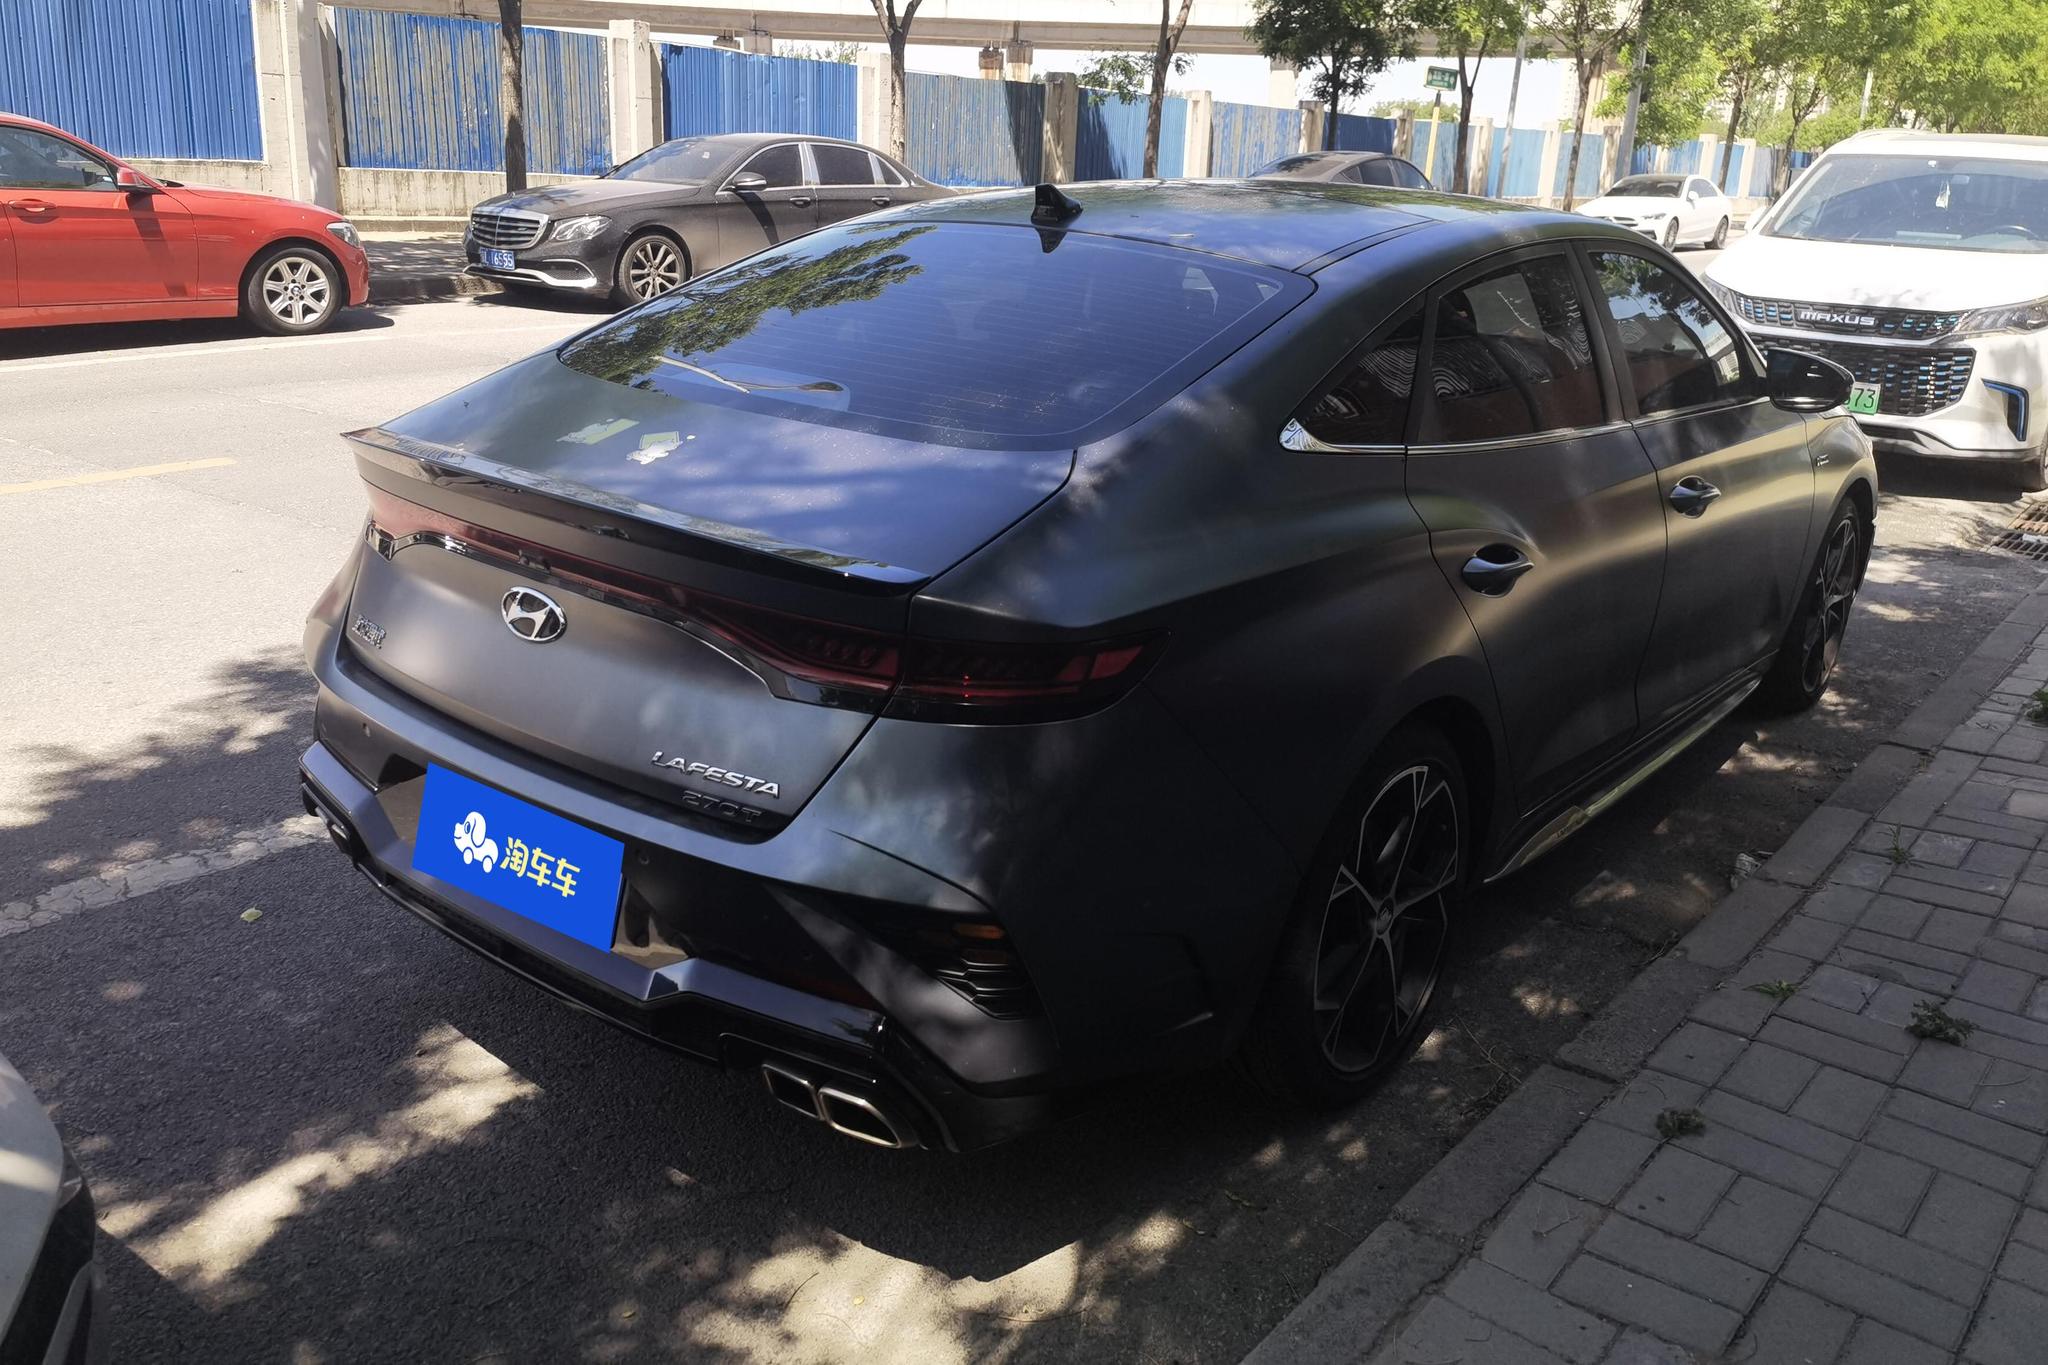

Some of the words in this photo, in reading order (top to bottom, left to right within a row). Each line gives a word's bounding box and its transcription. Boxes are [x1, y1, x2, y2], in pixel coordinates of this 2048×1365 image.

[1799, 311, 1875, 325] MAXUS
[1844, 388, 1876, 408] 73
[651, 750, 780, 799] LAFESTA
